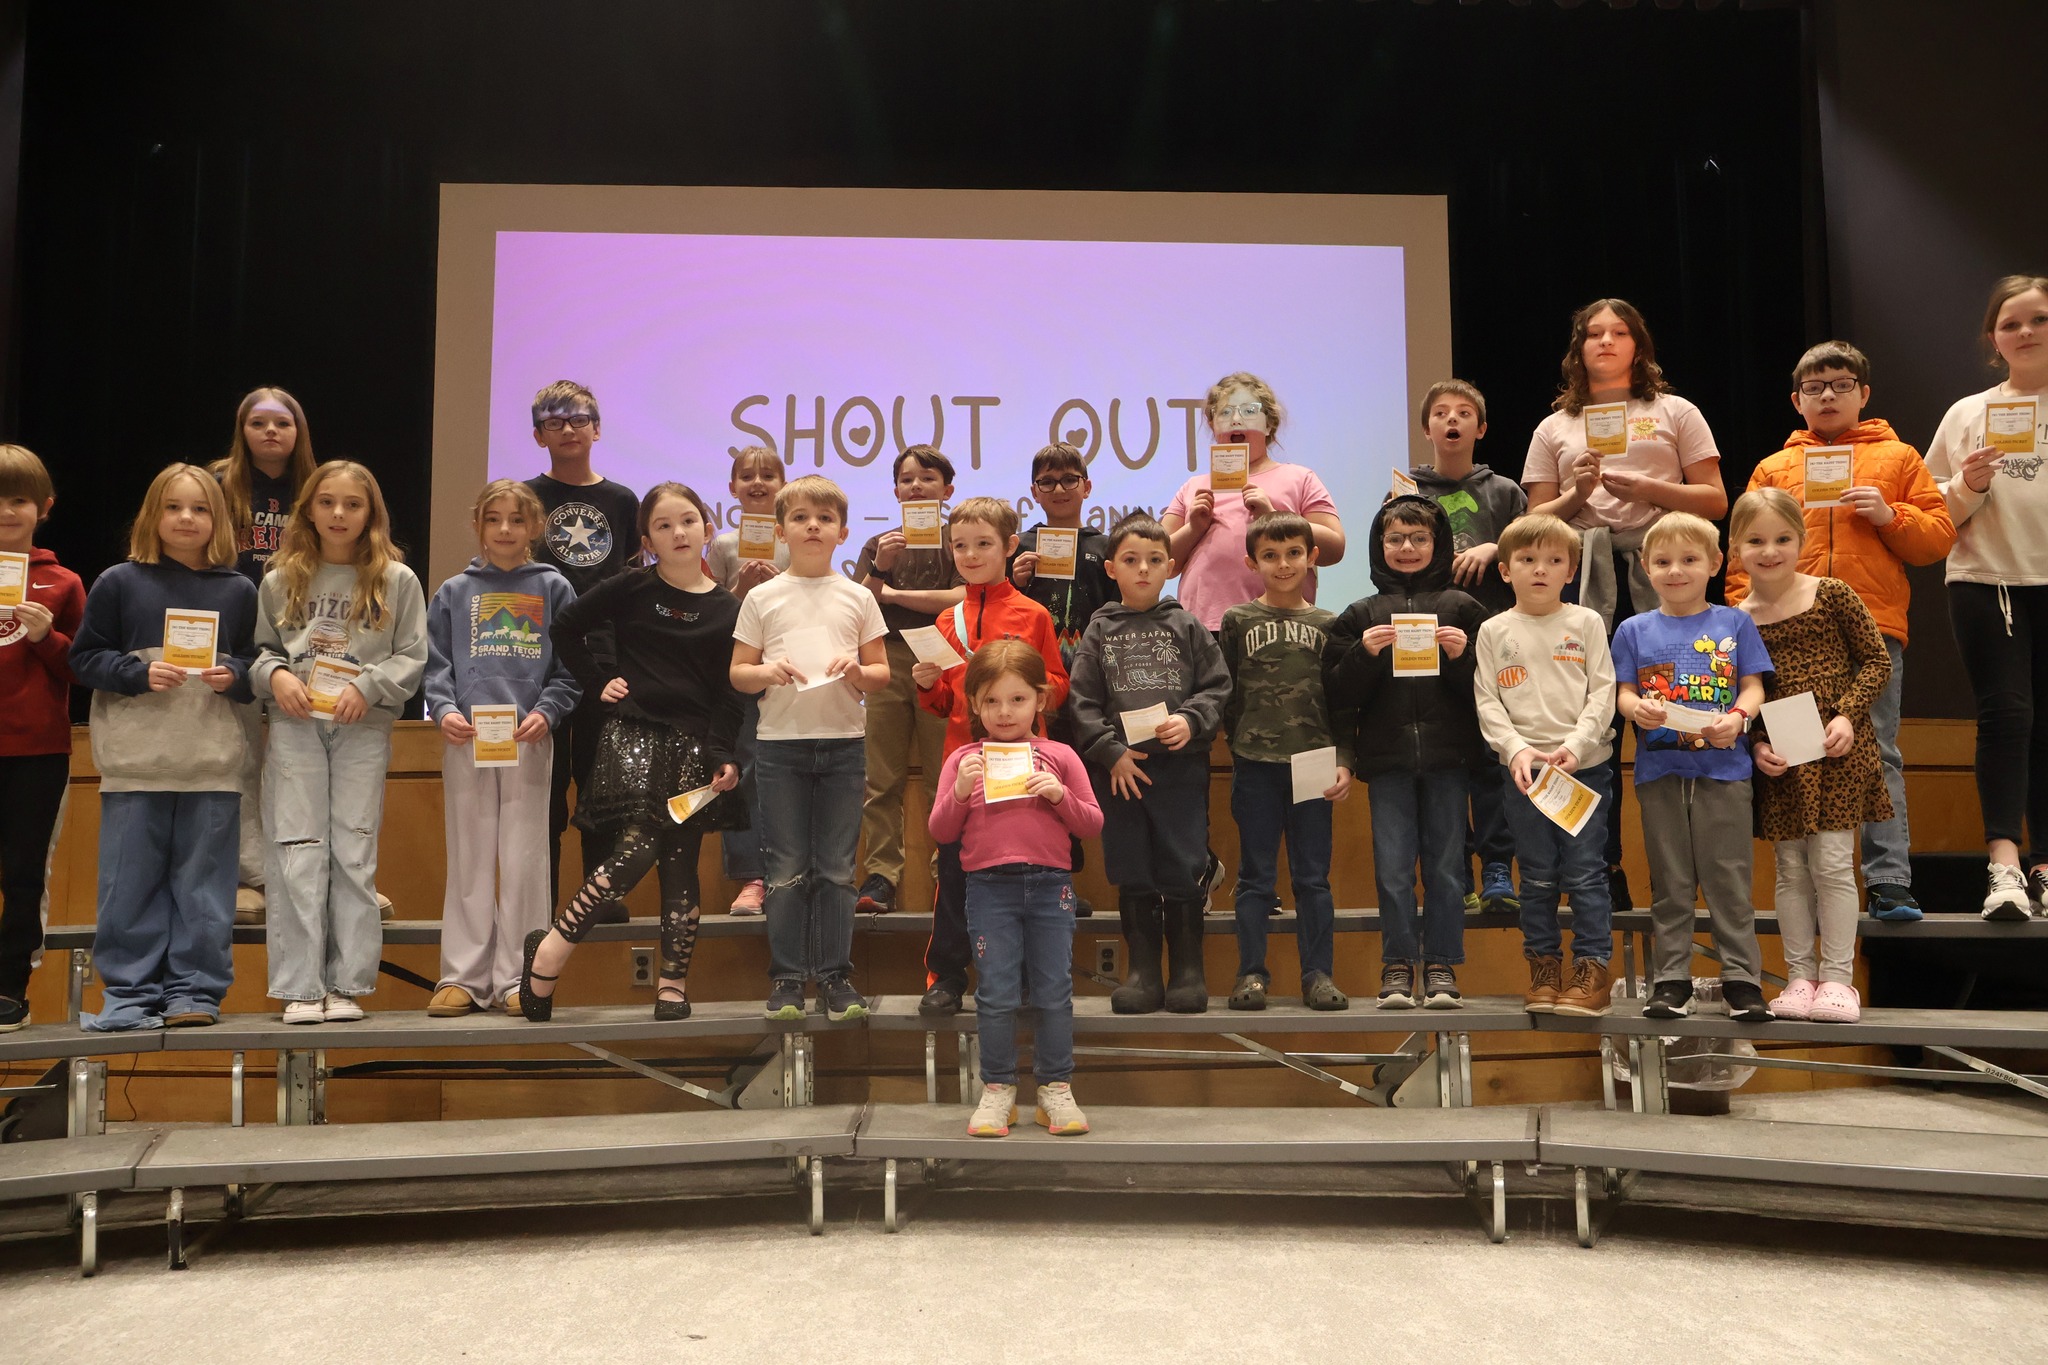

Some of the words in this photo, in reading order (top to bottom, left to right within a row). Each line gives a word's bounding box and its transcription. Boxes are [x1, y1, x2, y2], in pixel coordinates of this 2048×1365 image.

[727, 393, 1000, 471] SHOUT
[1049, 396, 1204, 472] OUT
[268, 498, 280, 513] B
[254, 511, 290, 528] CAM
[553, 507, 605, 529] CONVERSE
[252, 553, 271, 562] POST
[557, 544, 574, 560] ALL
[577, 549, 602, 561] STAR
[470, 594, 480, 659] WYOMING
[1105, 632, 1137, 642] WATER
[1141, 630, 1176, 639] SAFARI
[1245, 621, 1278, 657] OLD
[1283, 620, 1329, 660] NAVY
[478, 644, 509, 653] GRAND
[512, 645, 541, 655] TETON
[1553, 655, 1585, 664] NATUR
[1678, 673, 1729, 688] SUPER
[1670, 685, 1733, 705] MARIO
[1985, 1067, 2019, 1085] 024F806
